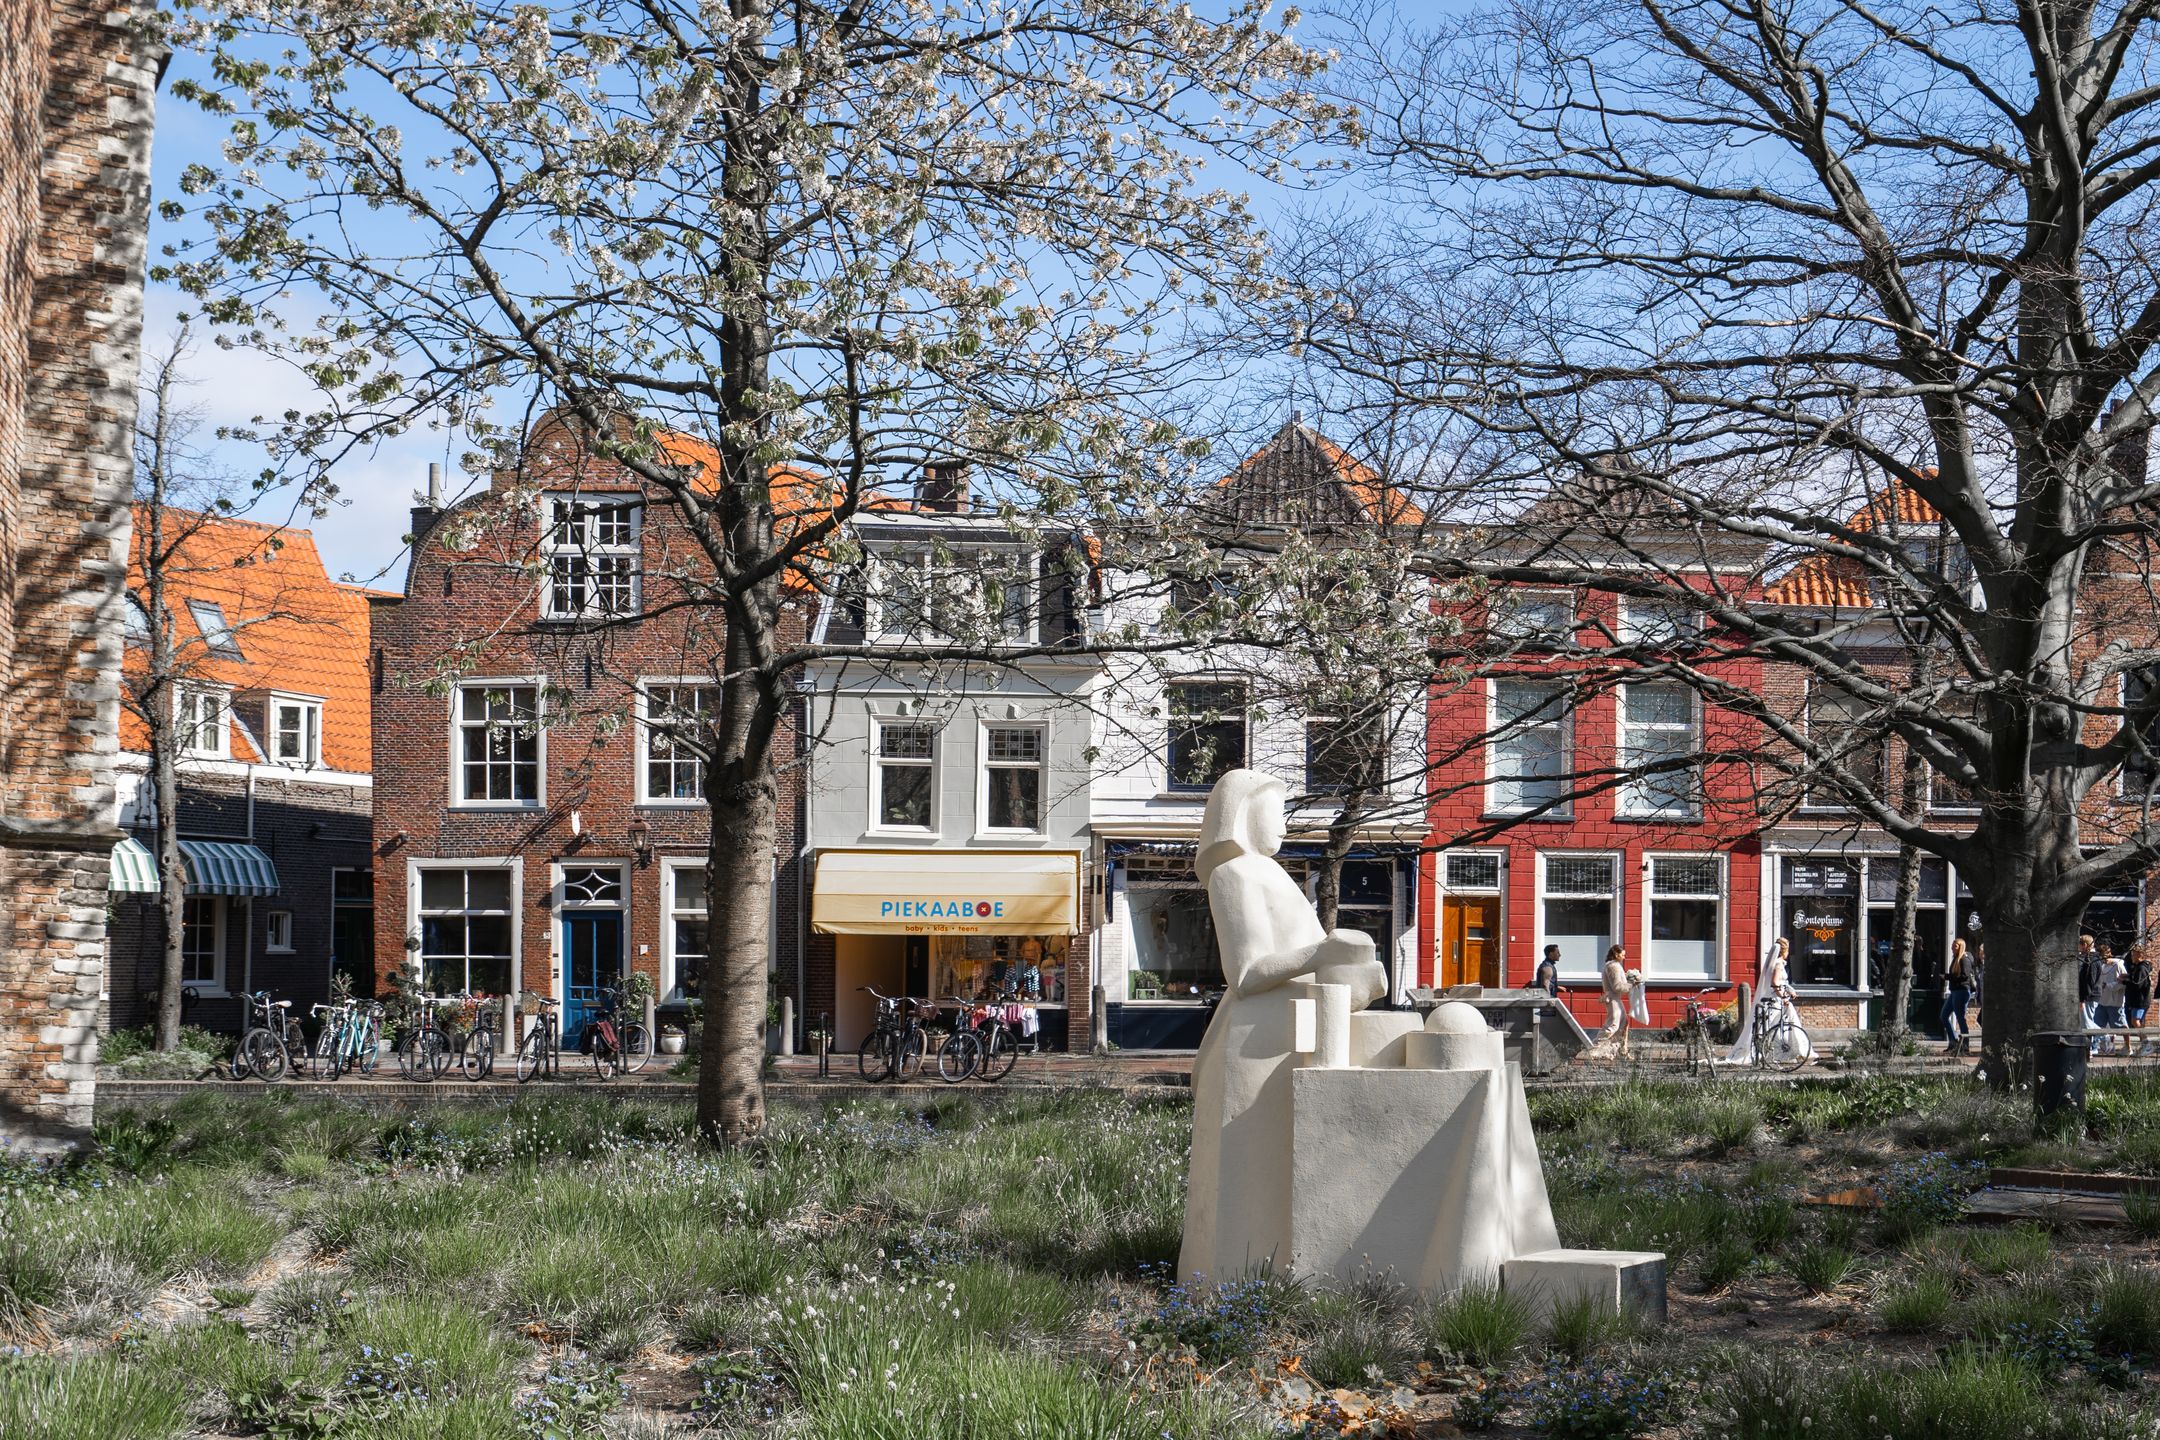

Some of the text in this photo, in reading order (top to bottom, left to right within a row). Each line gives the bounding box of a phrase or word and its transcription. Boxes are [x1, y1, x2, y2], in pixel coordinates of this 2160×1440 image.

[1362, 876, 1368, 886] 5
[881, 901, 1003, 917] PIEKAABOE
[905, 925, 924, 933] baby
[958, 925, 979, 933] teens
